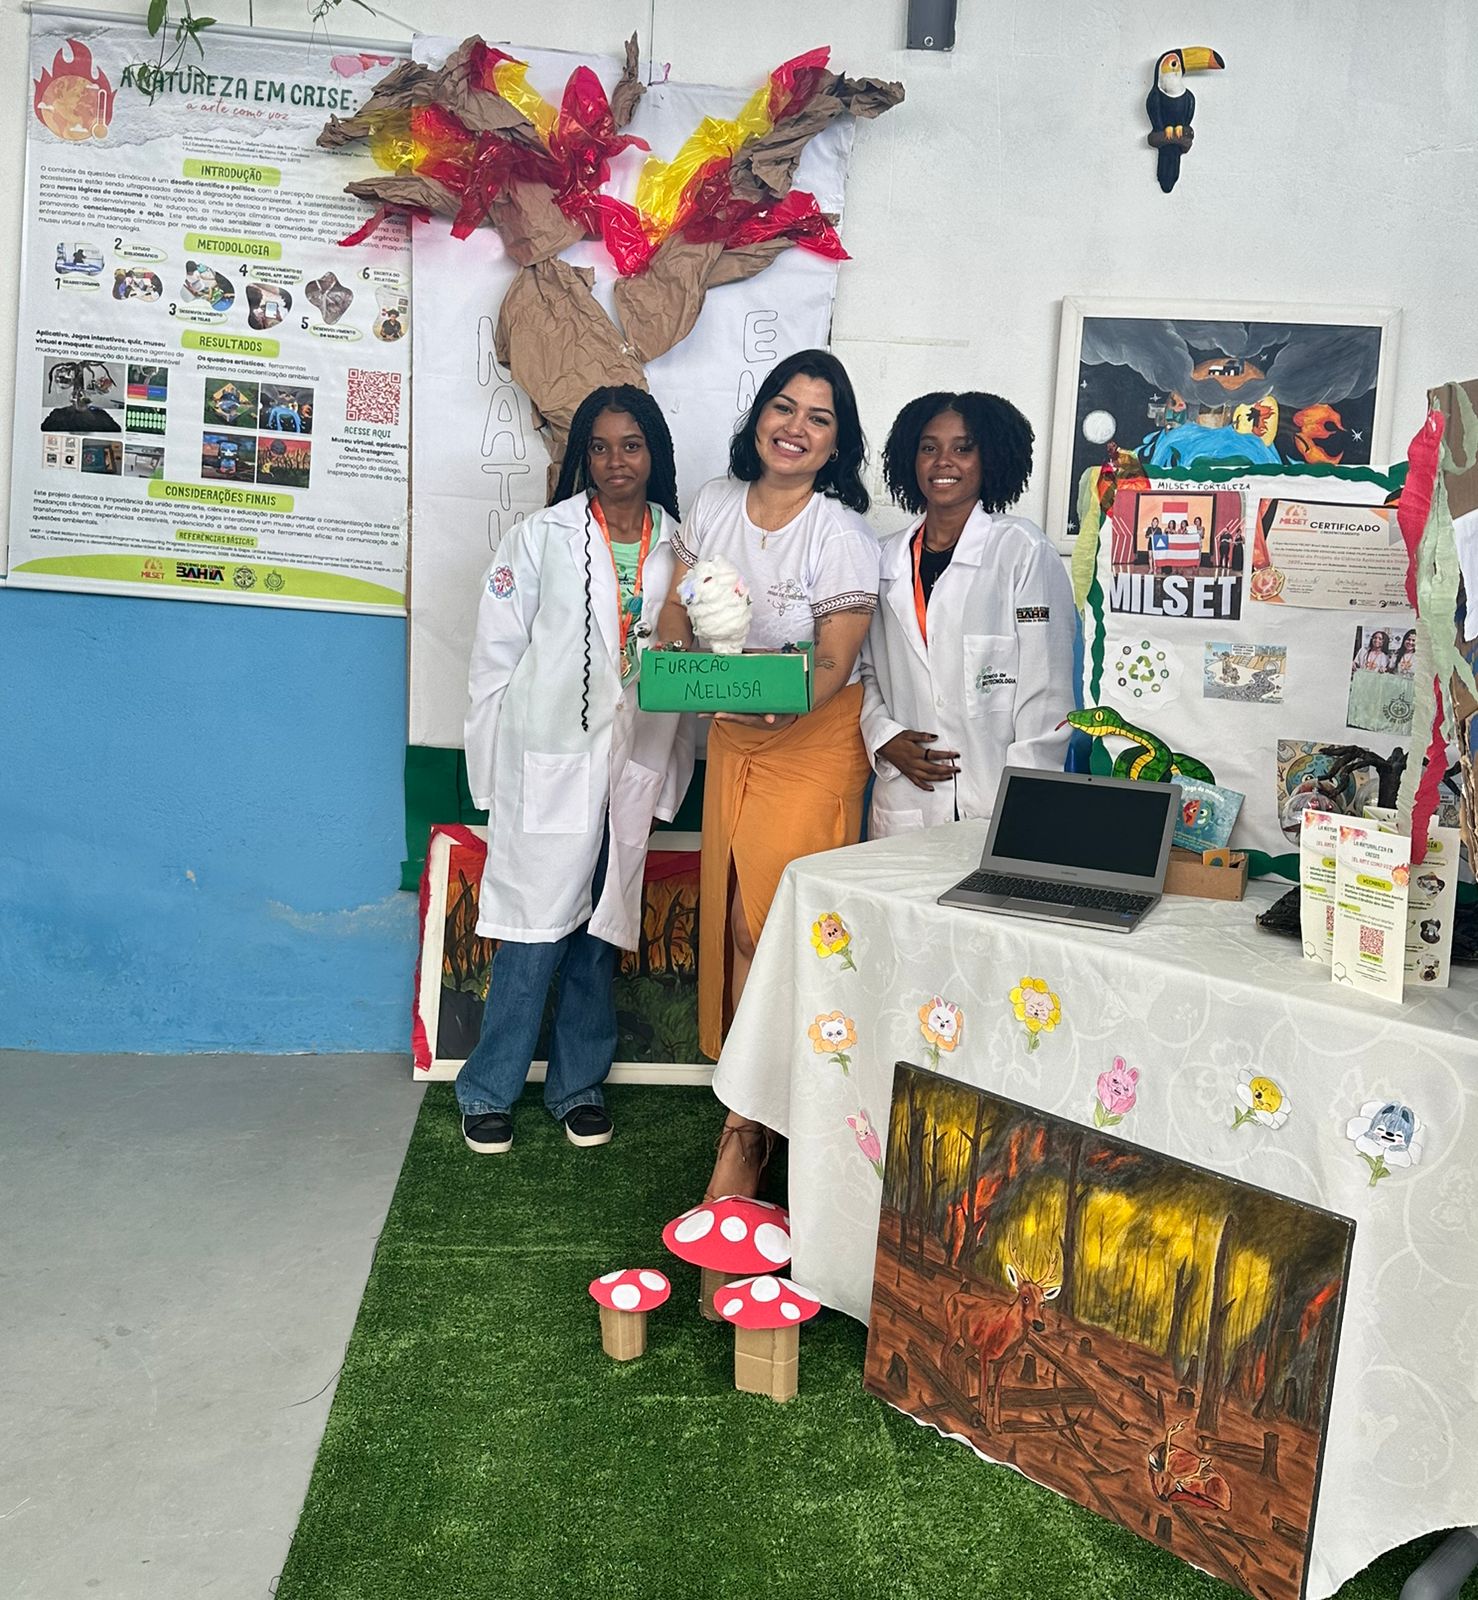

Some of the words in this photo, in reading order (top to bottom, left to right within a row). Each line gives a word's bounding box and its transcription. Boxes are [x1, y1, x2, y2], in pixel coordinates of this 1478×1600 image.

[120, 67, 132, 88] A
[254, 80, 285, 103] EM
[290, 84, 357, 112] CRISE:
[200, 98, 229, 114] arte
[232, 107, 265, 118] como
[268, 111, 288, 120] voz
[201, 166, 262, 183] INTRODUÇÃO
[114, 238, 122, 250] 2
[197, 239, 269, 256] METODOLOGIA
[239, 264, 248, 277] 4
[363, 267, 370, 279] 6
[55, 278, 61, 290] 1
[169, 303, 177, 316] 3
[301, 316, 309, 329] 5
[199, 336, 262, 352] RESULTADOS
[288, 372, 319, 381] ambiental
[331, 435, 352, 443] Museu
[344, 426, 371, 436] ACESSE
[372, 429, 391, 439] AQUI
[166, 486, 244, 504] CONSIDERAÇÕES
[245, 494, 276, 506] FINAIS
[1310, 521, 1380, 532] CERTIFICADO
[179, 531, 225, 544] REFERÊNCIAS
[226, 535, 255, 546] BÁSICAS
[141, 571, 165, 580] MILSET
[1110, 572, 1236, 617] MILSET
[654, 654, 729, 674] FURACÃO
[684, 680, 761, 700] MELISSA
